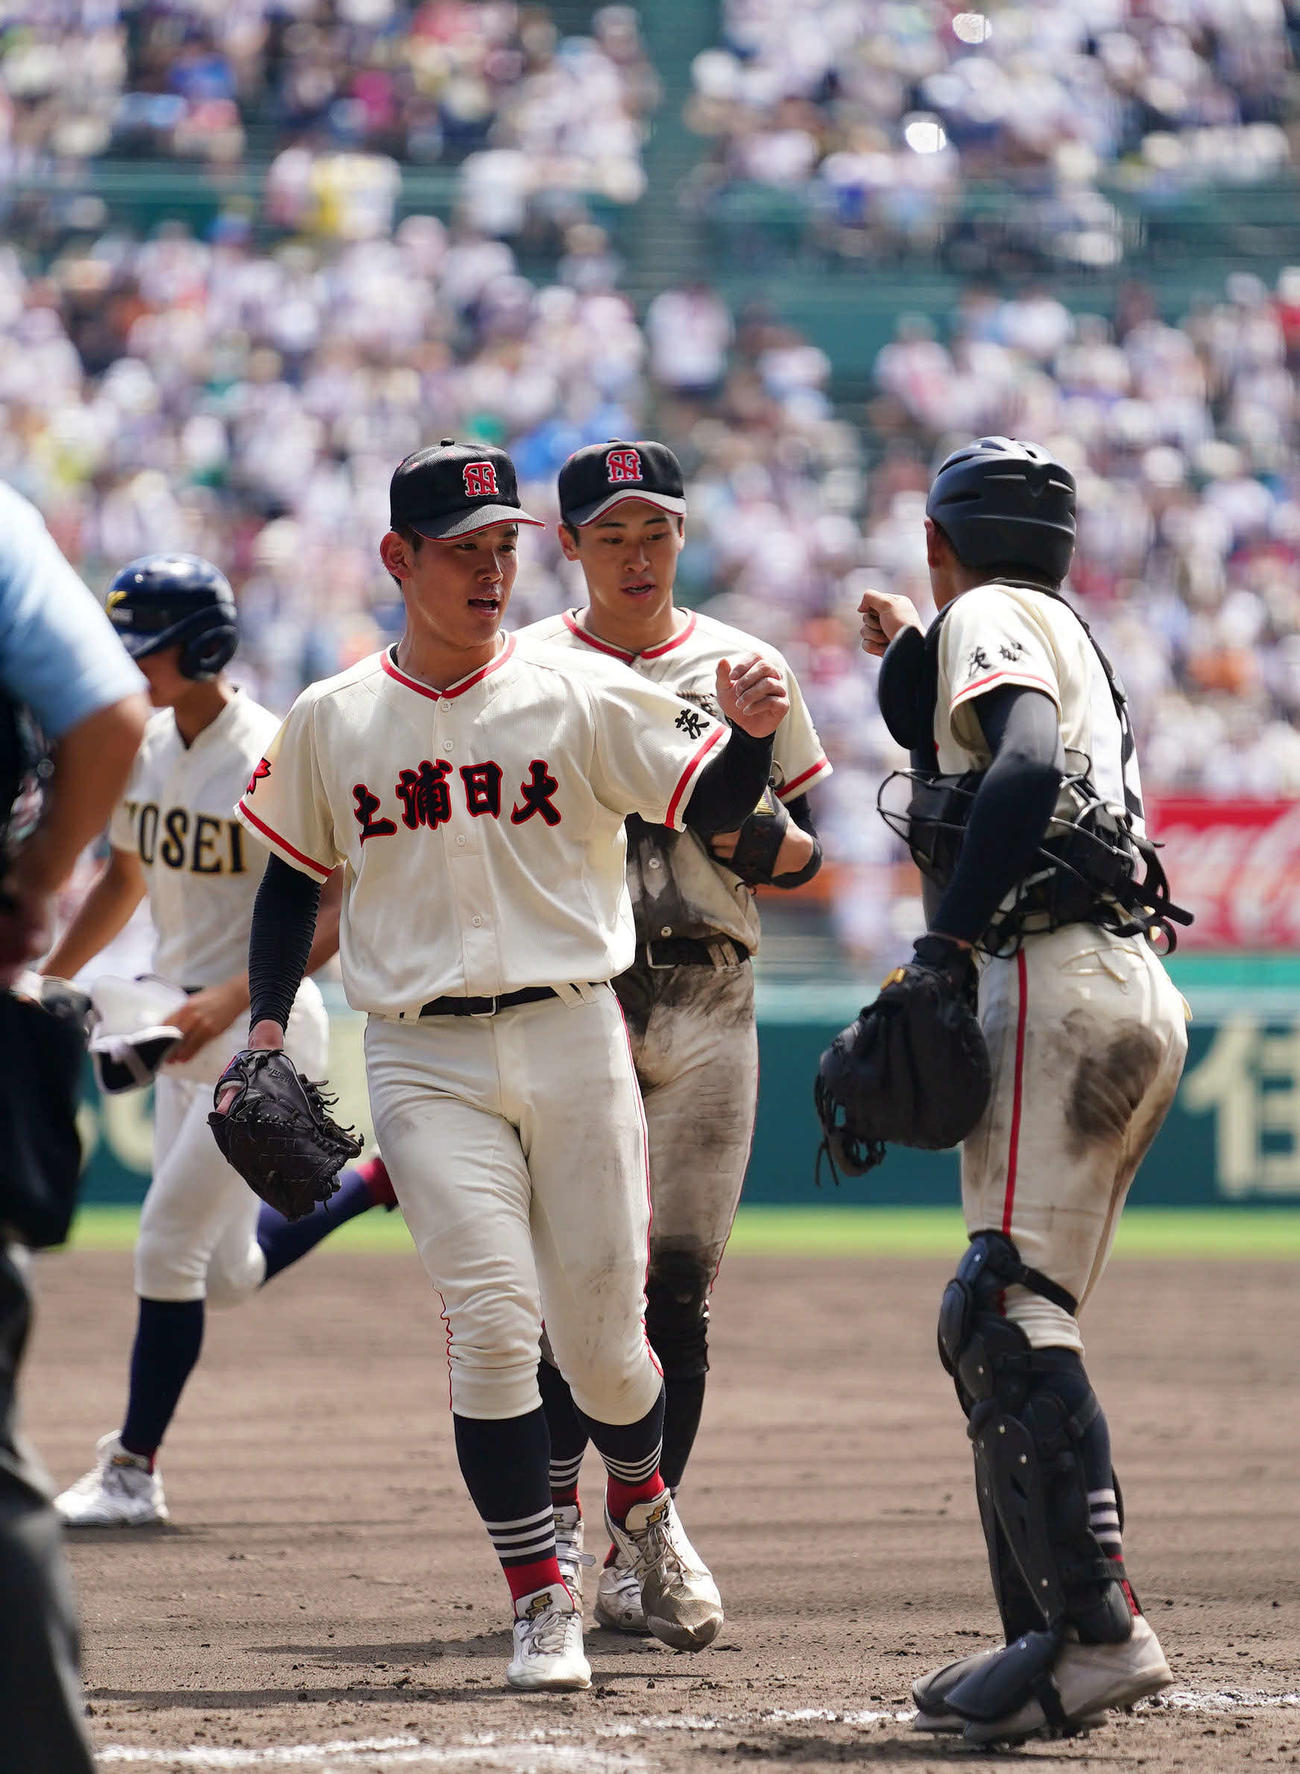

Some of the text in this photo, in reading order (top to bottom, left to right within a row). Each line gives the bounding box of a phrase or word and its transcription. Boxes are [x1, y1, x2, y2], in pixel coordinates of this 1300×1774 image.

[125, 801, 247, 874] OSEI
[352, 758, 562, 848] 土浦日大
